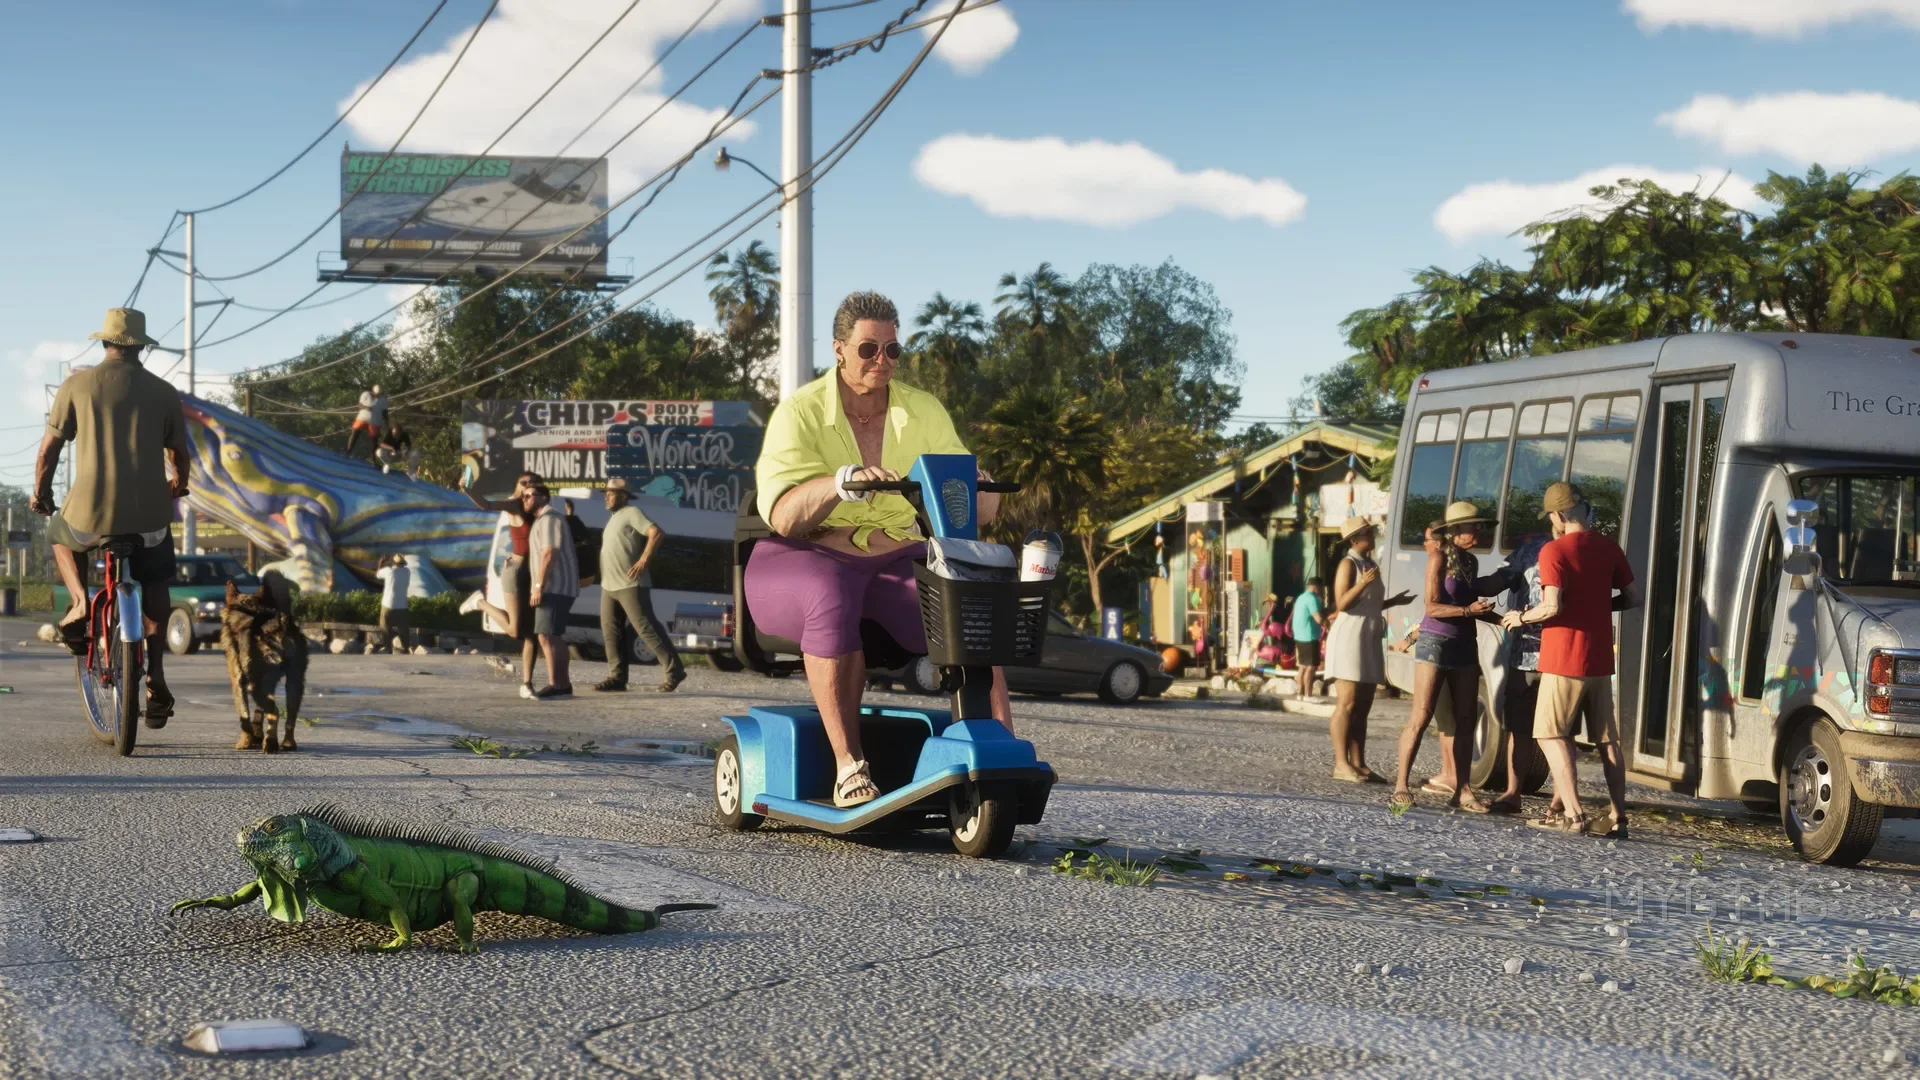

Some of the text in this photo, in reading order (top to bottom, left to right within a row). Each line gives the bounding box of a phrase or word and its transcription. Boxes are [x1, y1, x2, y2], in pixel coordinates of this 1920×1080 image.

[348, 155, 511, 177] KEEPS BUSINESS
[654, 404, 699, 415] BODY
[1826, 391, 1875, 413] The
[527, 402, 648, 426] CHIP'S
[654, 415, 699, 426] SHOP
[523, 451, 581, 479] HAVING
[584, 451, 596, 479] A
